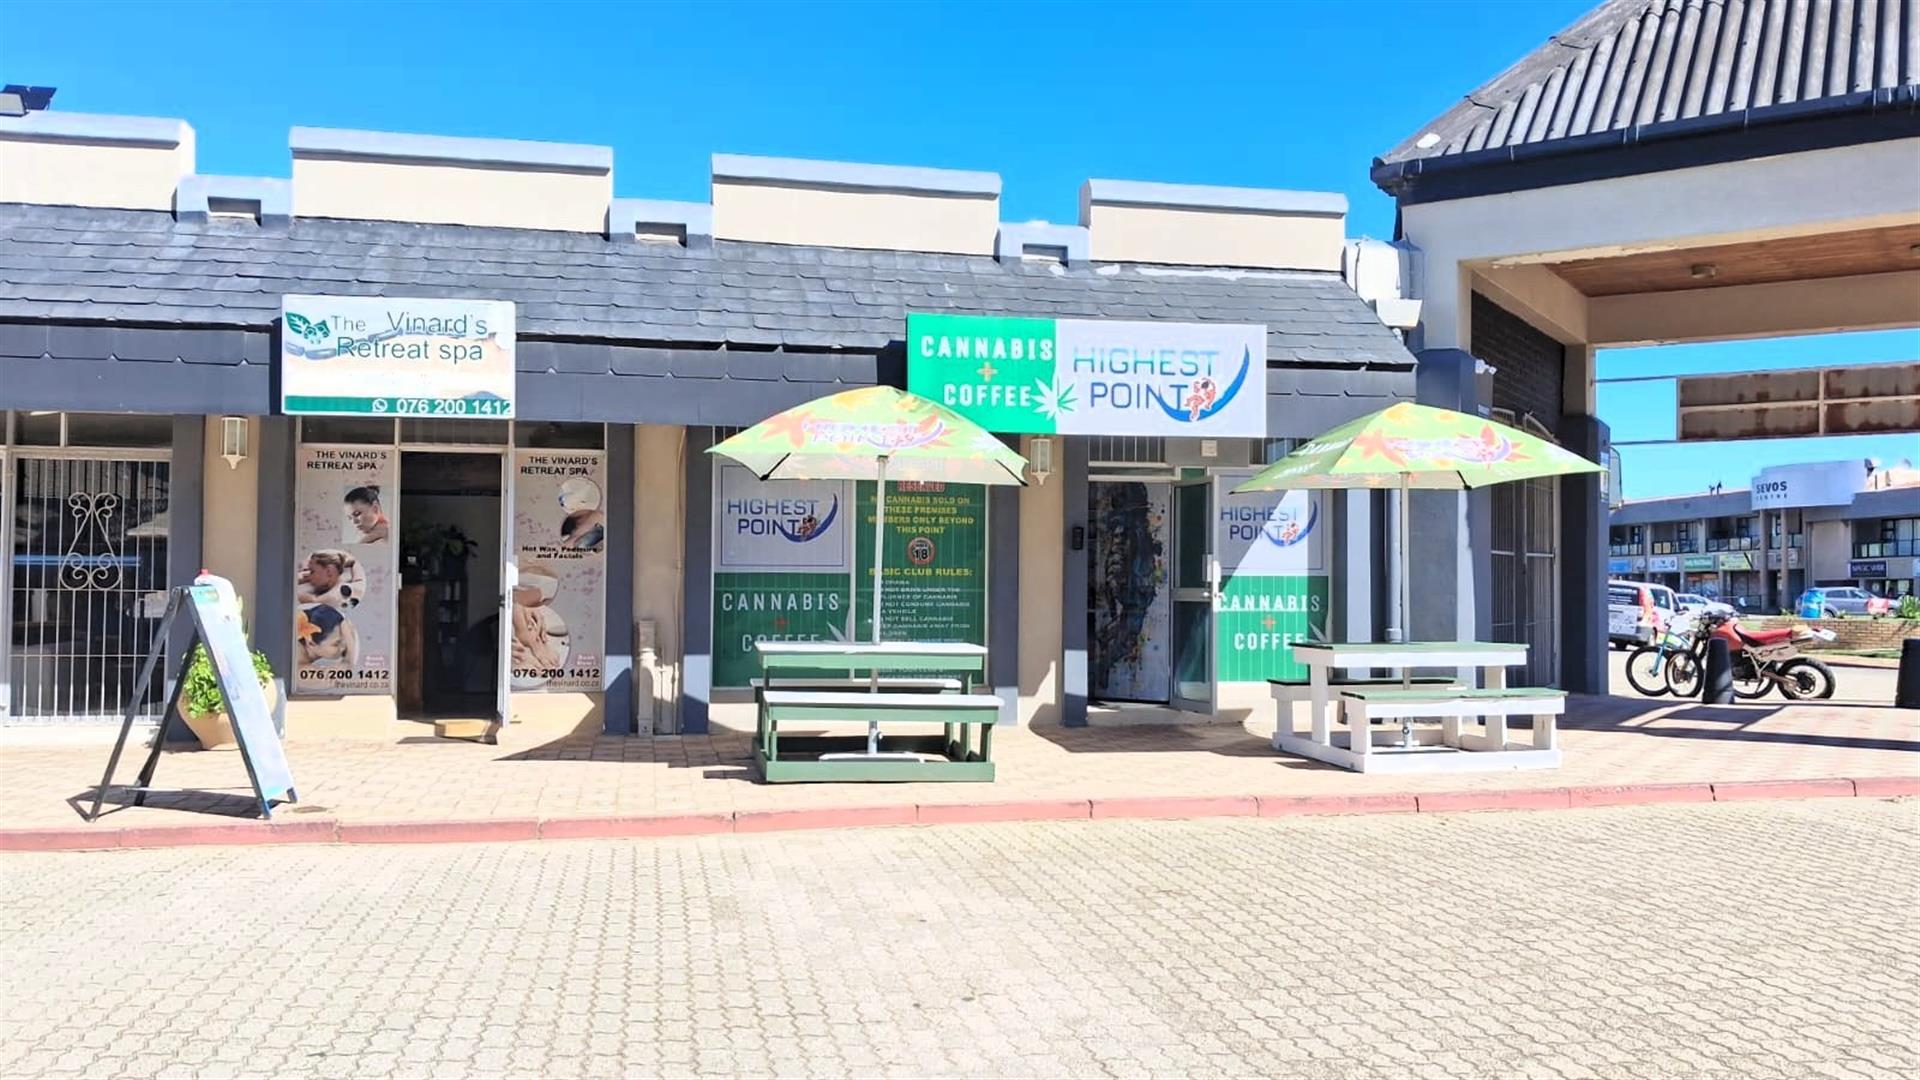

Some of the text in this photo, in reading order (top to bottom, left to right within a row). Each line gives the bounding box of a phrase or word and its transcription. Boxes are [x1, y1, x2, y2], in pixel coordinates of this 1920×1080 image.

[331, 311, 488, 335] The Vinard's
[337, 336, 483, 364] Retreat spa
[920, 335, 1054, 362] CANNABIS
[1073, 346, 1221, 377] HIGHEST
[943, 383, 1032, 407] COFFEE
[1090, 382, 1189, 410] POINT
[396, 400, 512, 416] 076 200 1412
[316, 450, 336, 459] THE
[529, 456, 598, 465] THE VINARD'S
[307, 461, 377, 470] RETREAT SPA
[521, 466, 588, 475] RETREAT SPA
[1756, 481, 1788, 494] SEVOS
[886, 495, 931, 504] CANNABIS
[933, 497, 956, 505] SOLD
[957, 497, 970, 505] ON
[727, 499, 819, 515] HIGHEST
[884, 505, 957, 515] THESE PREMISES
[867, 515, 974, 525] MMBERS ONLY BEYOND
[1220, 506, 1298, 522] HIGHEST
[738, 518, 799, 535] POINT
[896, 526, 945, 534] THIS POINT
[914, 548, 929, 560] 18
[868, 567, 974, 577] BSIC CLUB RULES:
[722, 593, 840, 611] CANNABIS
[300, 670, 389, 680] 076 200 1412
[513, 668, 600, 678] 076 200 1412
